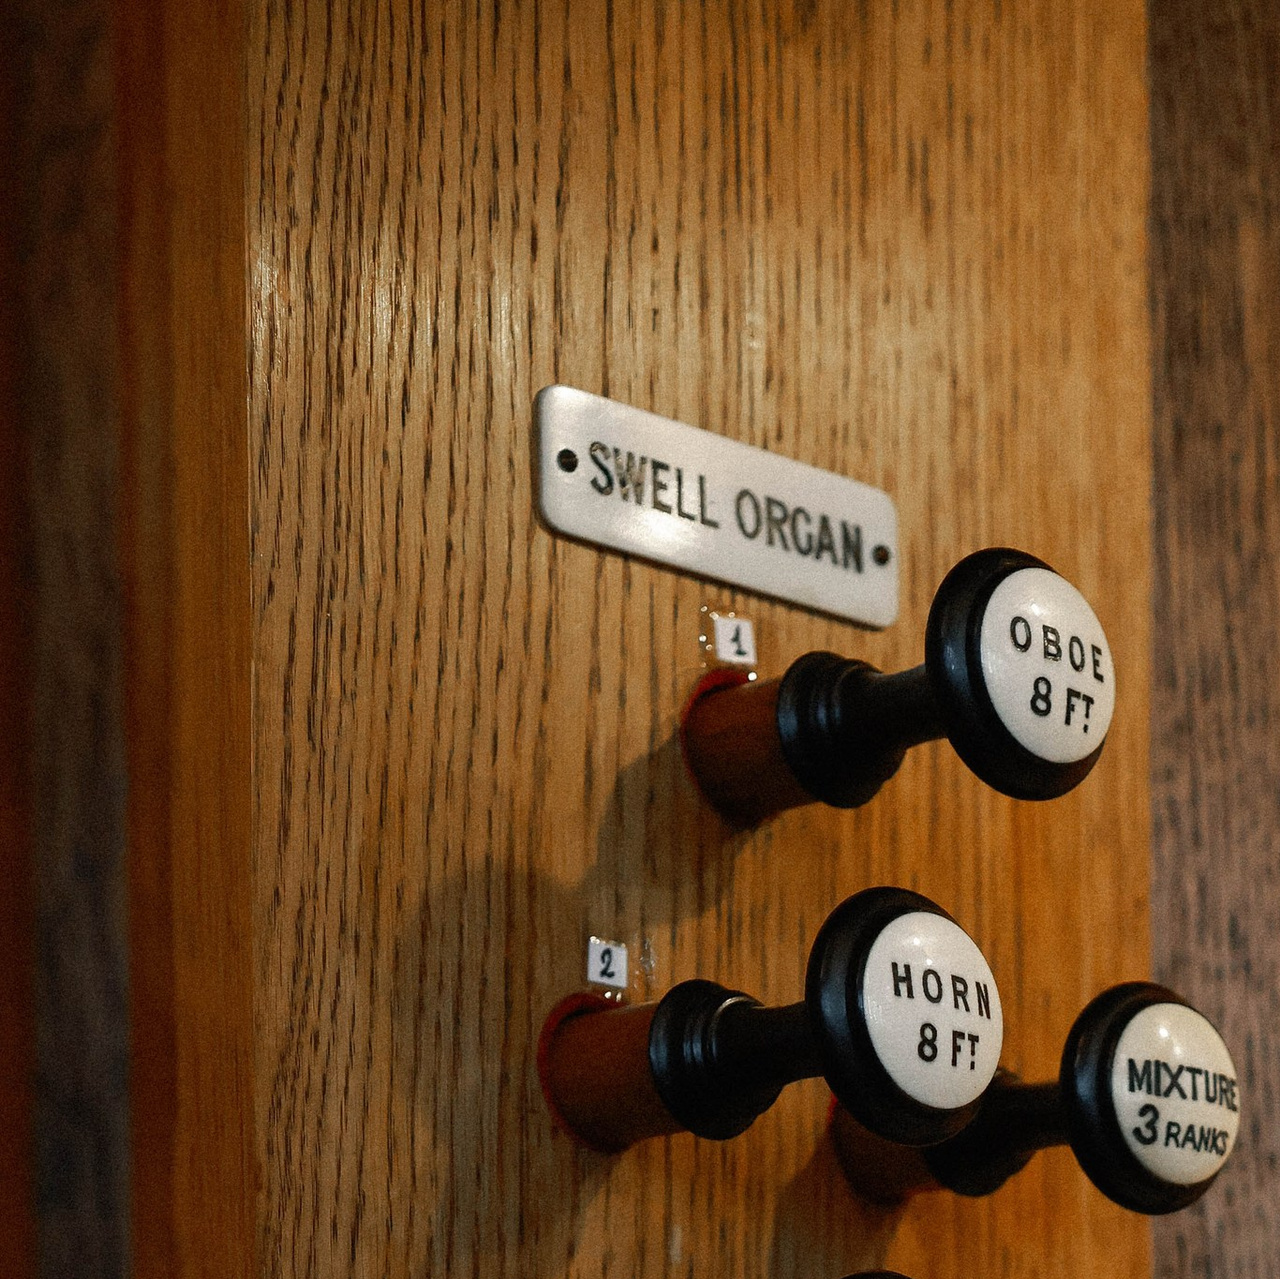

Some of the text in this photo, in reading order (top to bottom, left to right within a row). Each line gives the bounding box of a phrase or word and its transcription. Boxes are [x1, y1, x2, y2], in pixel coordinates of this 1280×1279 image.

[587, 441, 865, 574] SWELL ORGAN
[730, 624, 747, 656] 1
[1009, 616, 1104, 683] OBOE
[1029, 676, 1052, 717] 8
[600, 948, 615, 978] 2
[891, 962, 993, 1020] HORN
[917, 1023, 938, 1062] 8
[1126, 1058, 1238, 1112] MIXTURE
[1133, 1104, 1229, 1158] 3 RANKS
